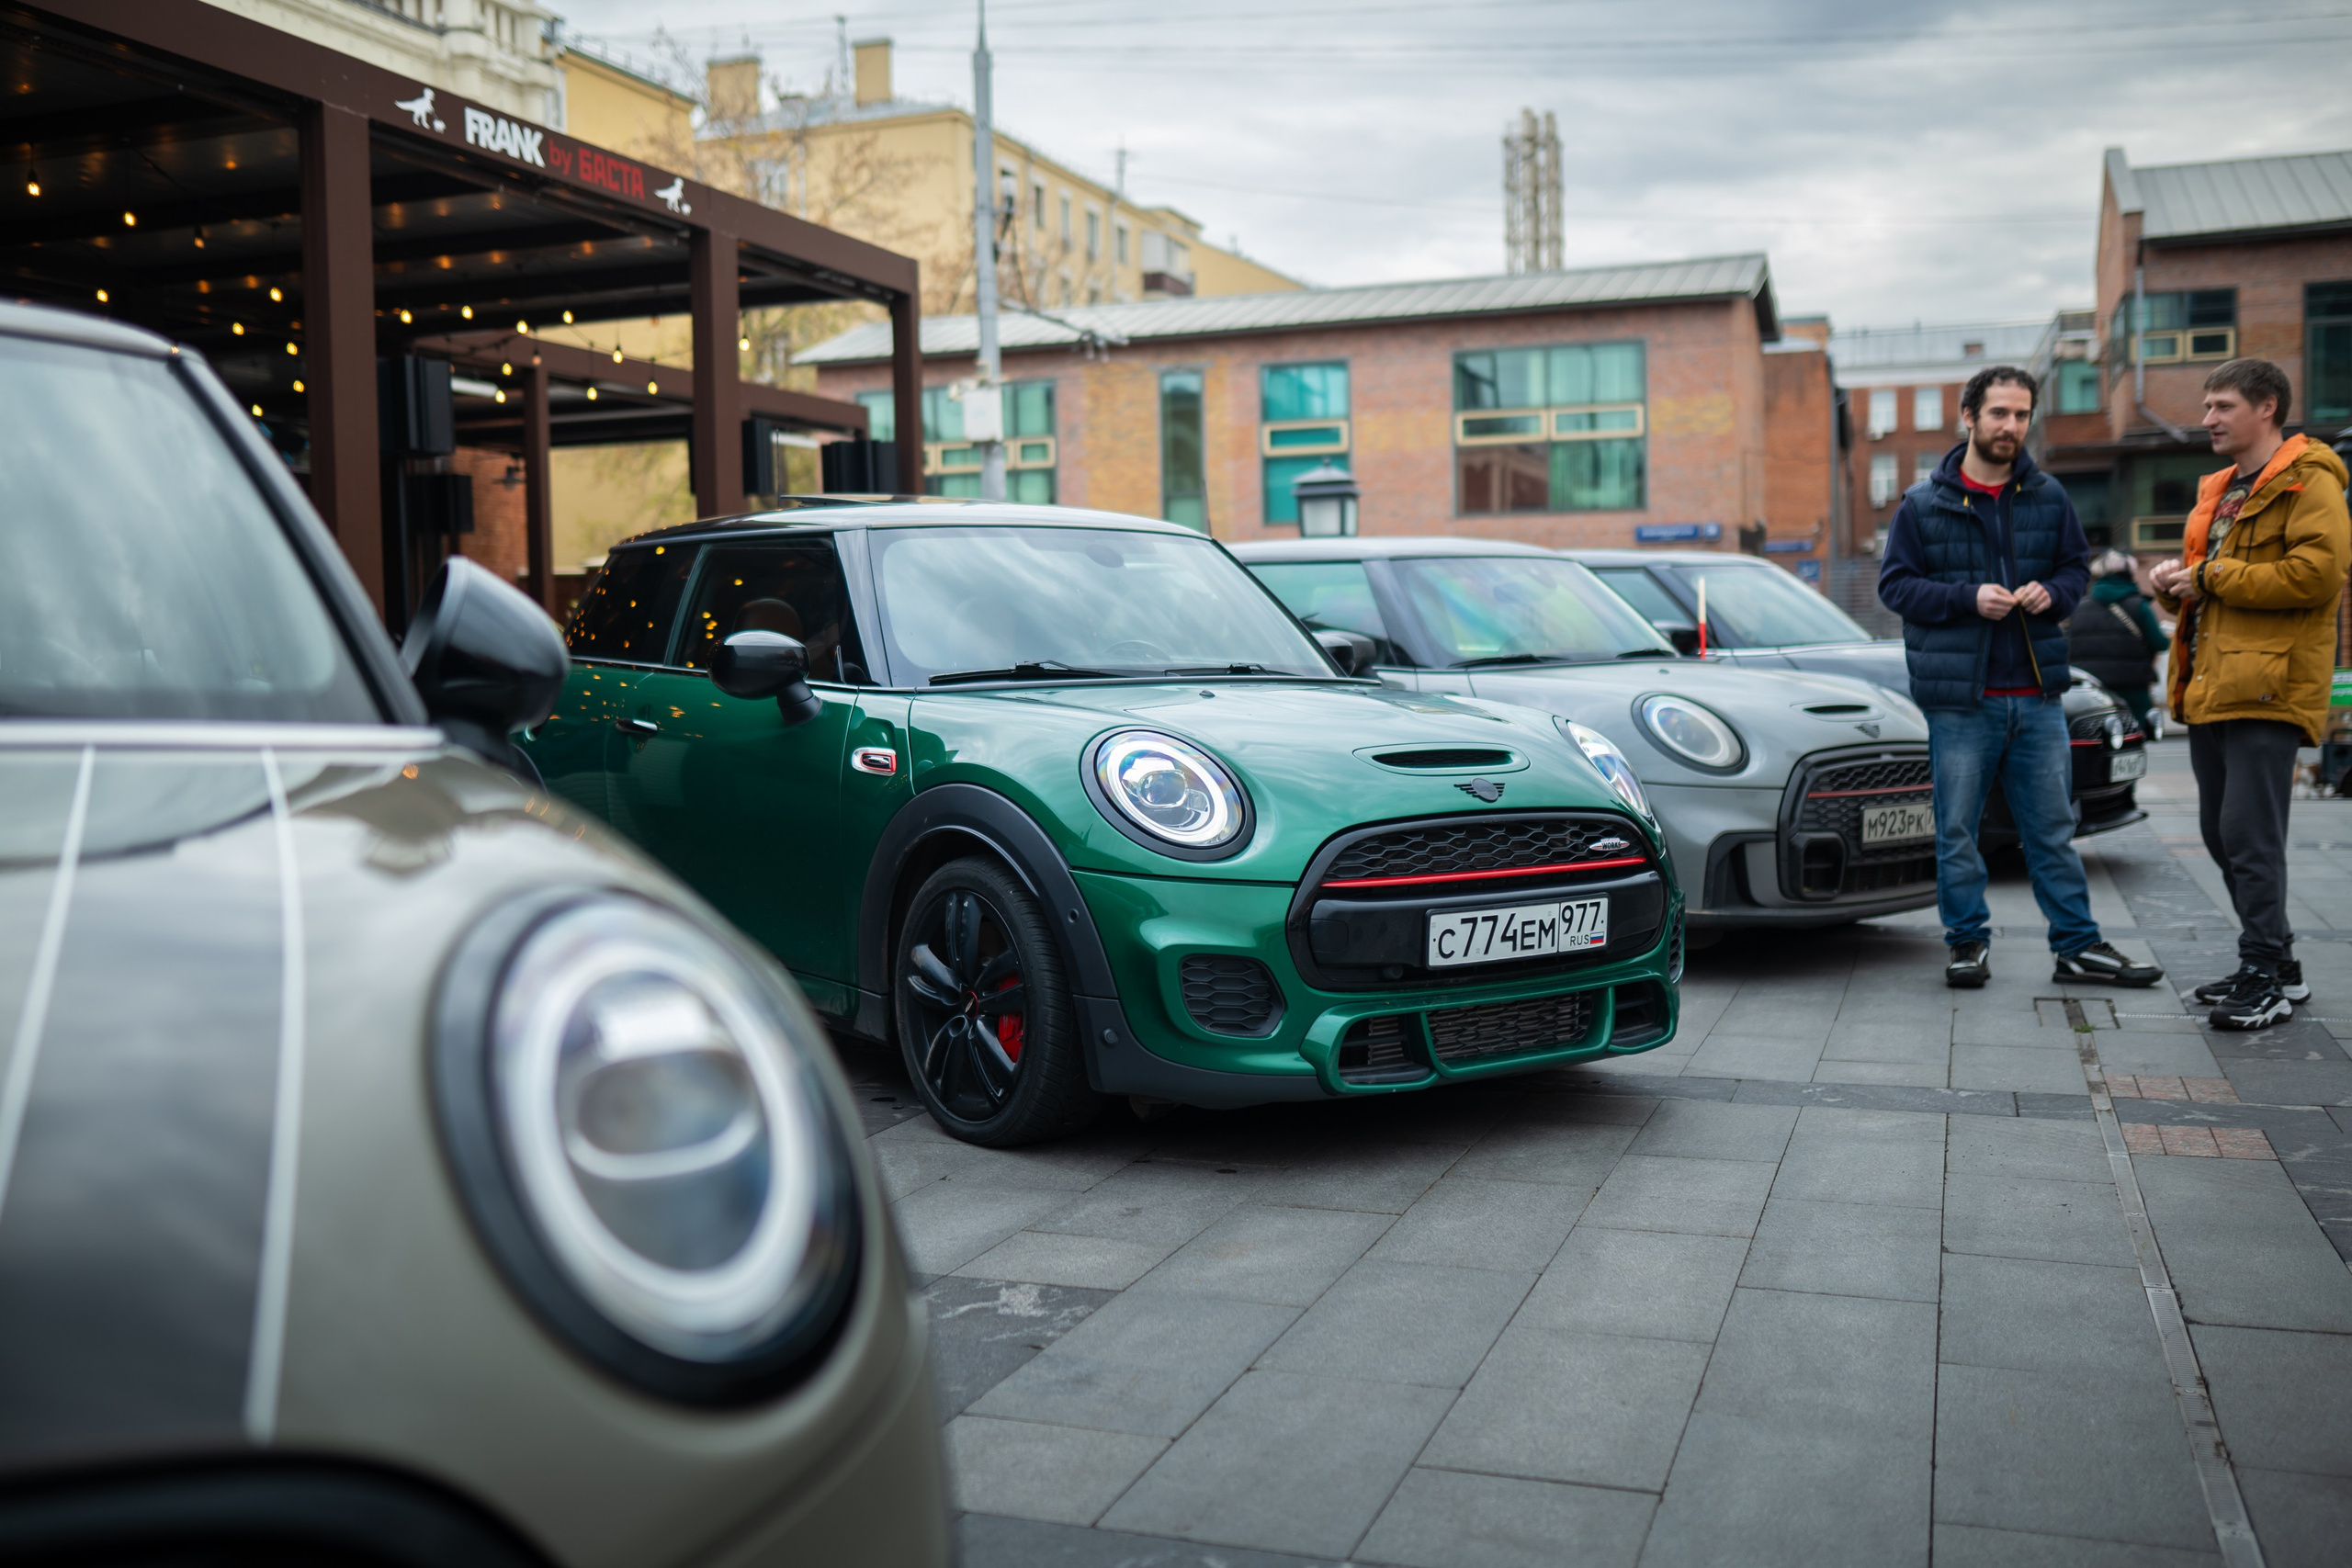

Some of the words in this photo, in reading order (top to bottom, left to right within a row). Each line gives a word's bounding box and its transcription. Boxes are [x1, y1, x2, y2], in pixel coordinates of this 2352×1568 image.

[464, 106, 546, 168] FRANK
[548, 139, 572, 175] by
[1601, 841, 1621, 850] WORKS
[1562, 901, 1600, 935] 977
[1570, 934, 1589, 946] RUS
